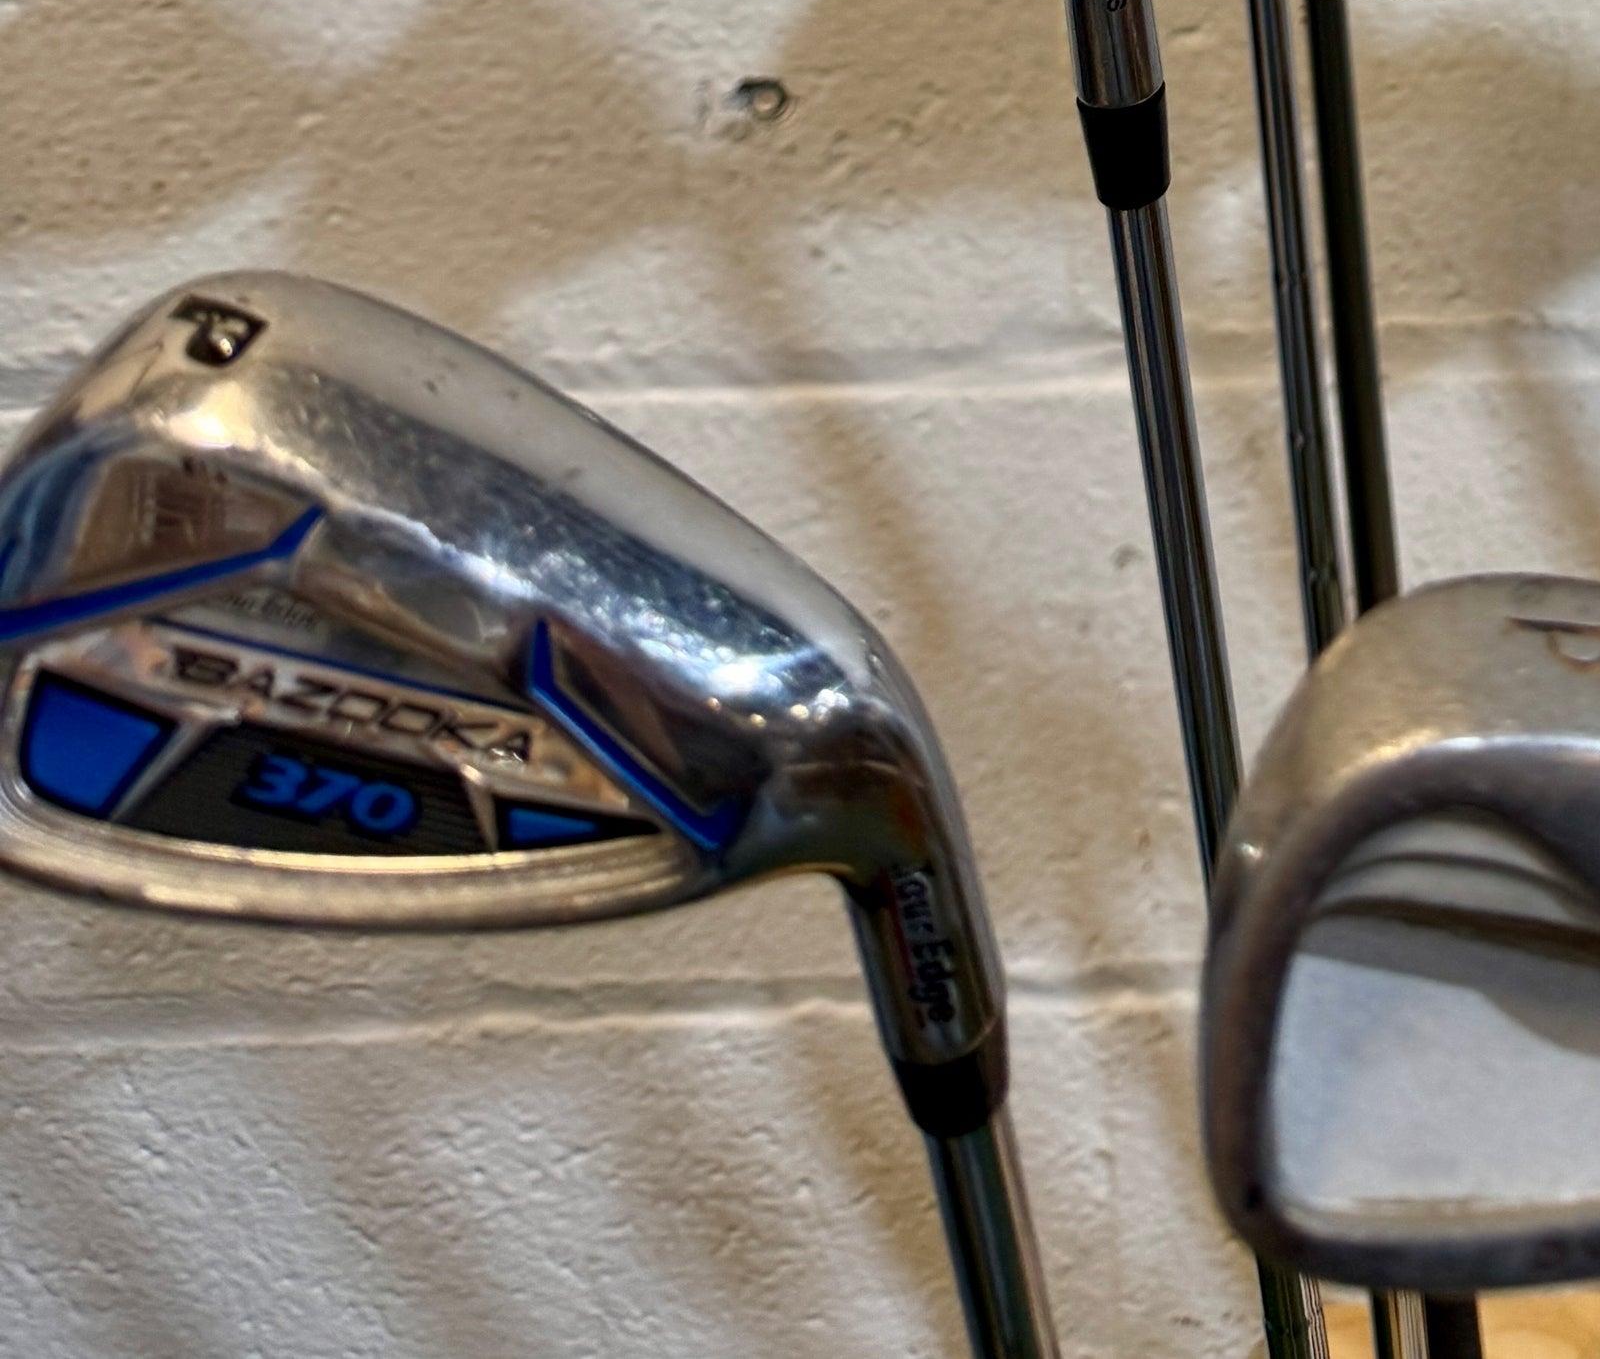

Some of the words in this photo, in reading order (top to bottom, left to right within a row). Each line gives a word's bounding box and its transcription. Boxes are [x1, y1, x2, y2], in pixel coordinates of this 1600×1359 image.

[174, 645, 536, 764] BAZOOKA
[236, 750, 422, 836] 370
[910, 939, 957, 1024] Edge
